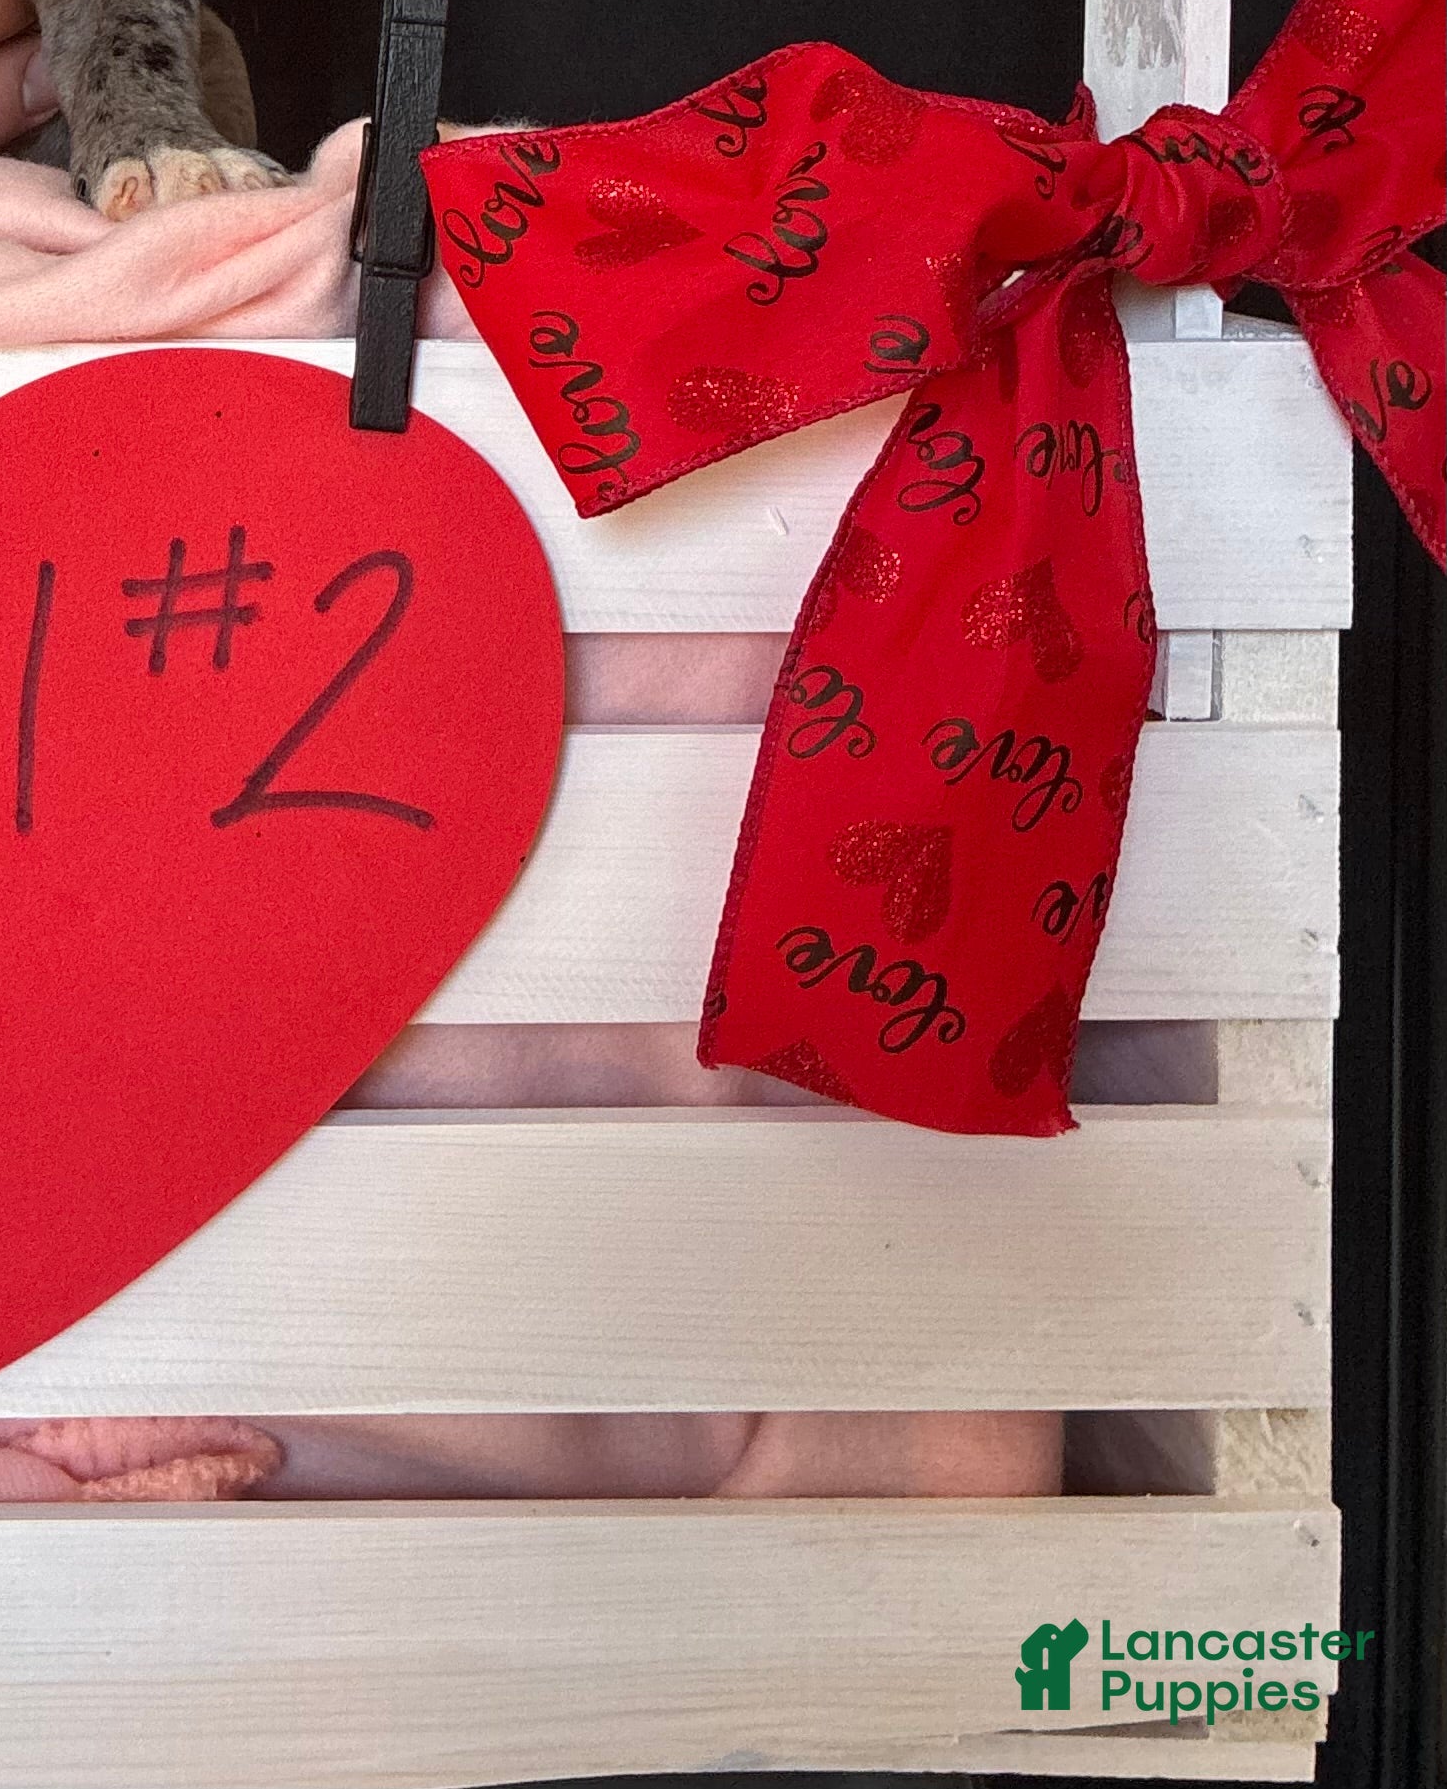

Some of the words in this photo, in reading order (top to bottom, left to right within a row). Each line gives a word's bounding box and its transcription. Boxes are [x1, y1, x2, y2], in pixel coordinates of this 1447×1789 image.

[441, 139, 562, 289] love
[527, 309, 642, 503] love
[122, 524, 434, 831] #2
[920, 717, 1084, 833] love
[775, 925, 967, 1055] love
